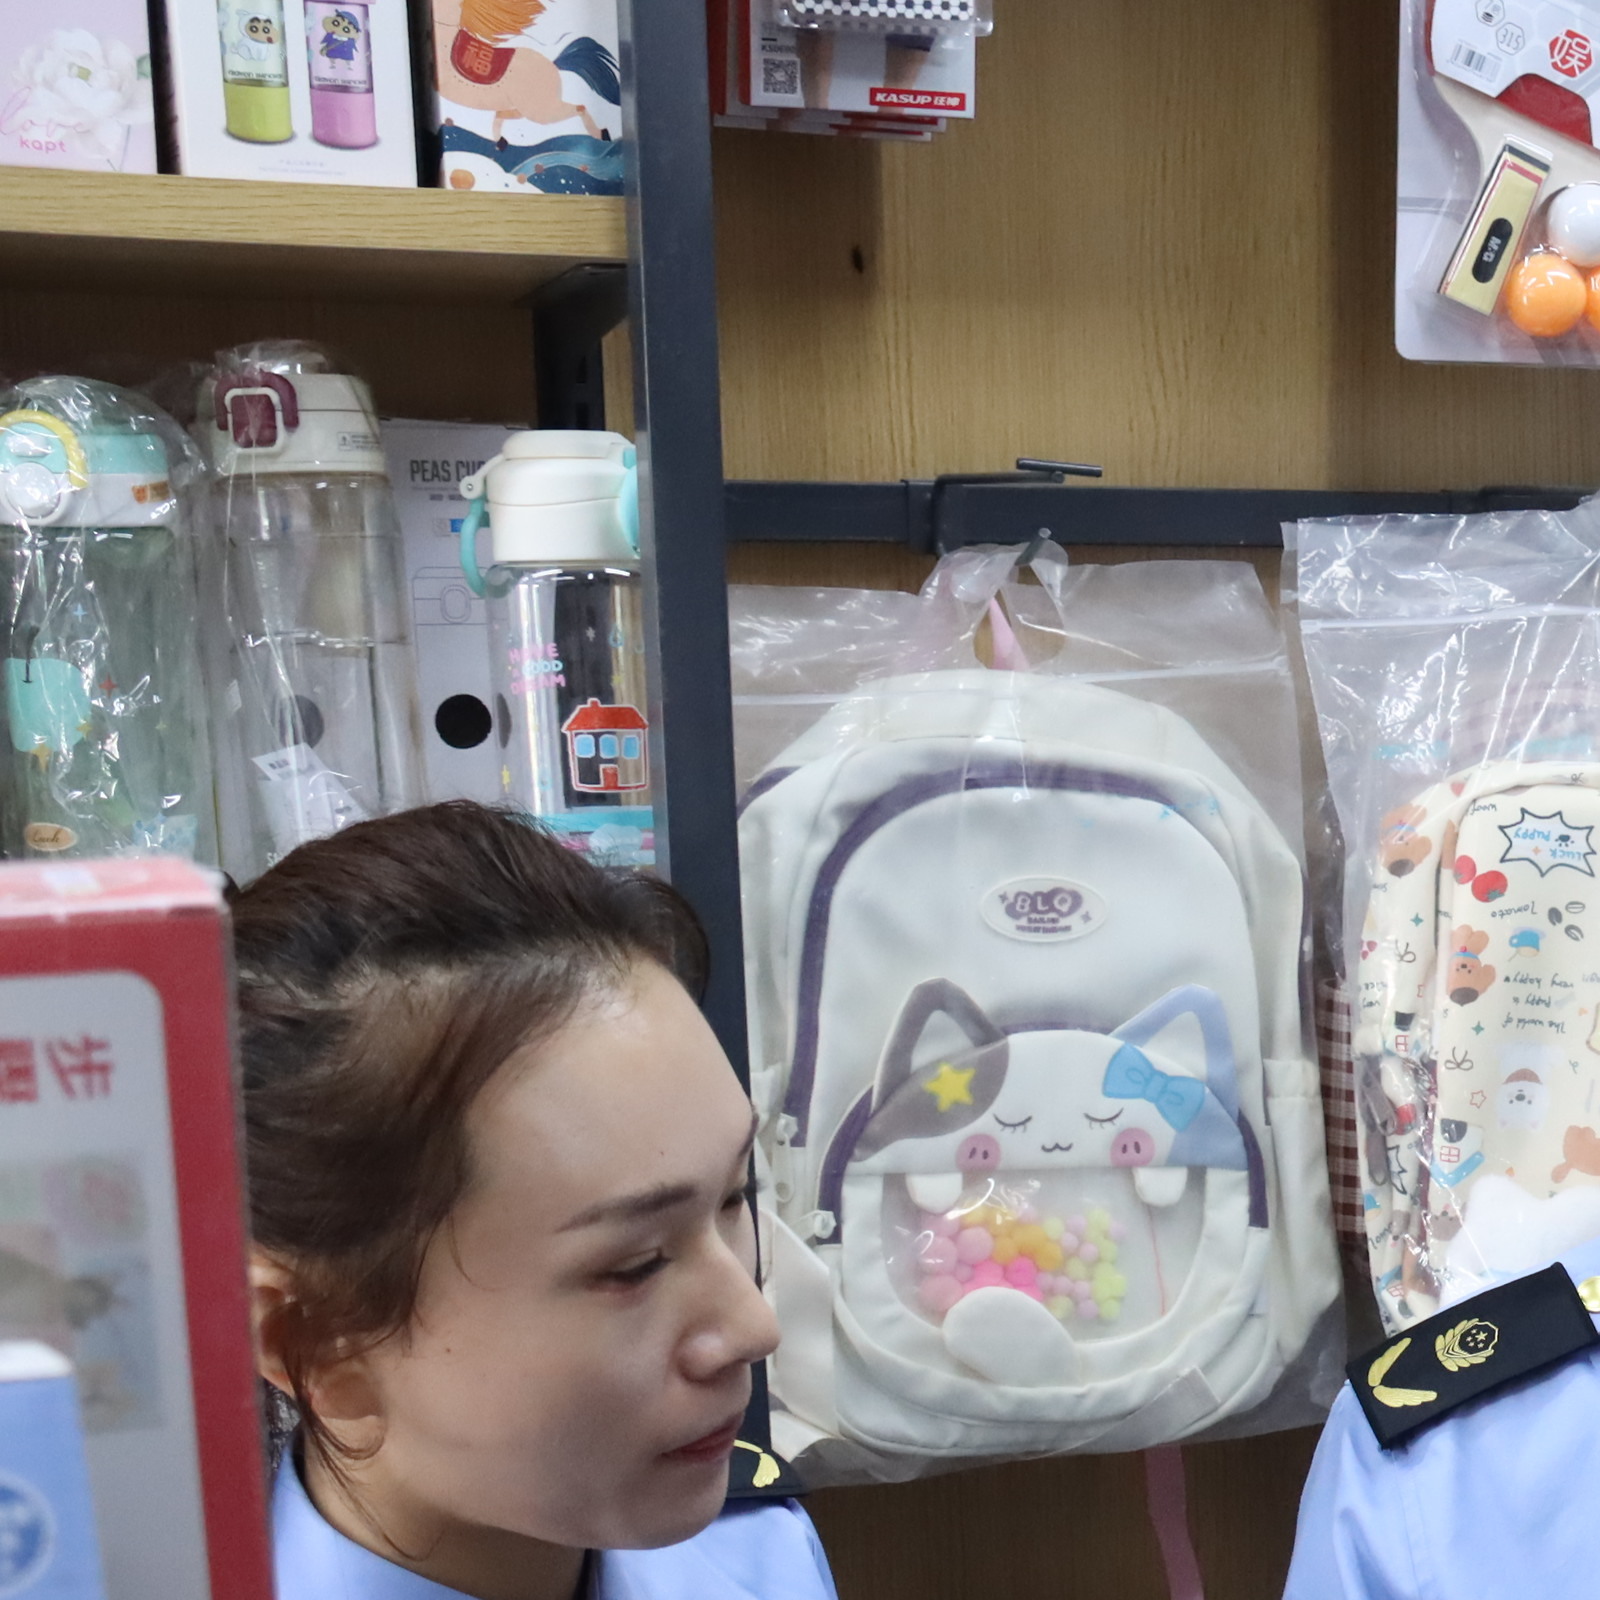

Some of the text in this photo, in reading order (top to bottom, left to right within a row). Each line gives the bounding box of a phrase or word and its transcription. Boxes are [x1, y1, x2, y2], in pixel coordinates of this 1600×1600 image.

[1499, 27, 1522, 51] 315
[1550, 32, 1592, 77] 娱
[875, 92, 932, 105] KASUP
[18, 136, 67, 154] kapt
[410, 459, 452, 483] PEAS
[1015, 892, 1073, 913] BLQ
[1490, 901, 1538, 919] Tomato
[1512, 972, 1543, 989] happy
[1517, 1016, 1545, 1031] world
